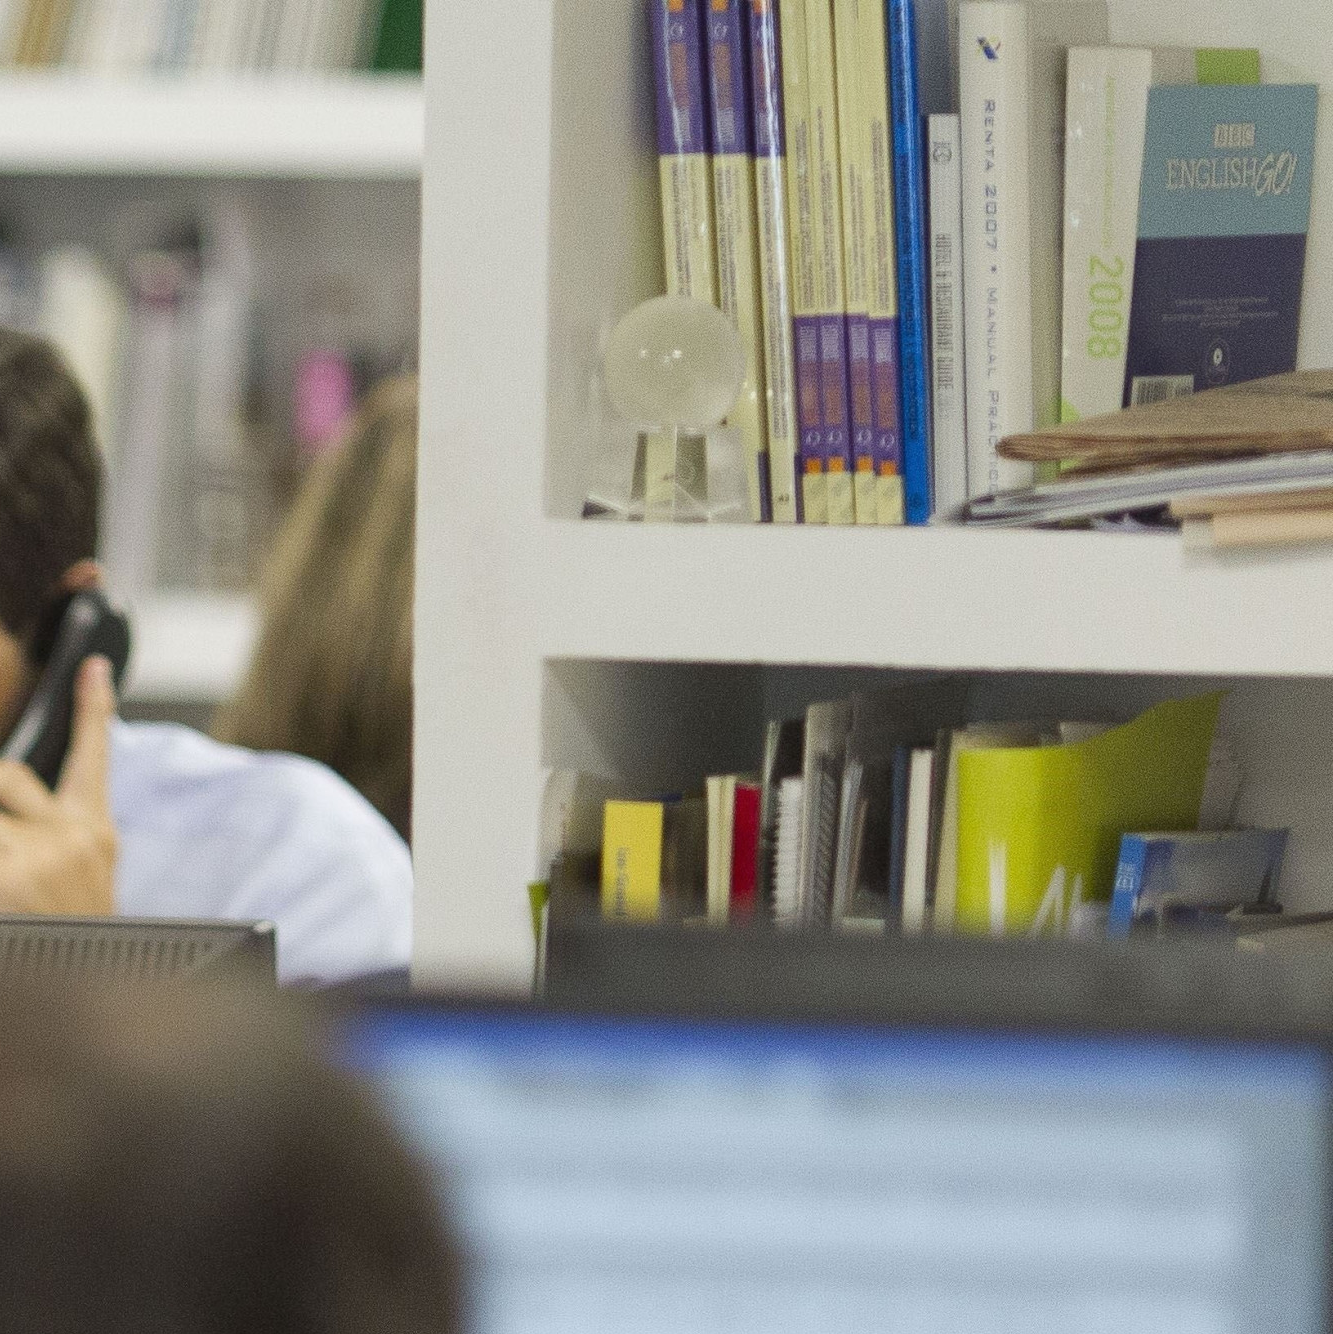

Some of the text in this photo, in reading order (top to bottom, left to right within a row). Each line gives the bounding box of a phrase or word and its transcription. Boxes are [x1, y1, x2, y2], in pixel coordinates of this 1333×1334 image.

[983, 98, 998, 173] RENTA
[984, 182, 999, 252] 2007
[986, 287, 999, 379] MANUAL
[1087, 254, 1124, 360] 2008
[937, 356, 954, 391] GUIDE
